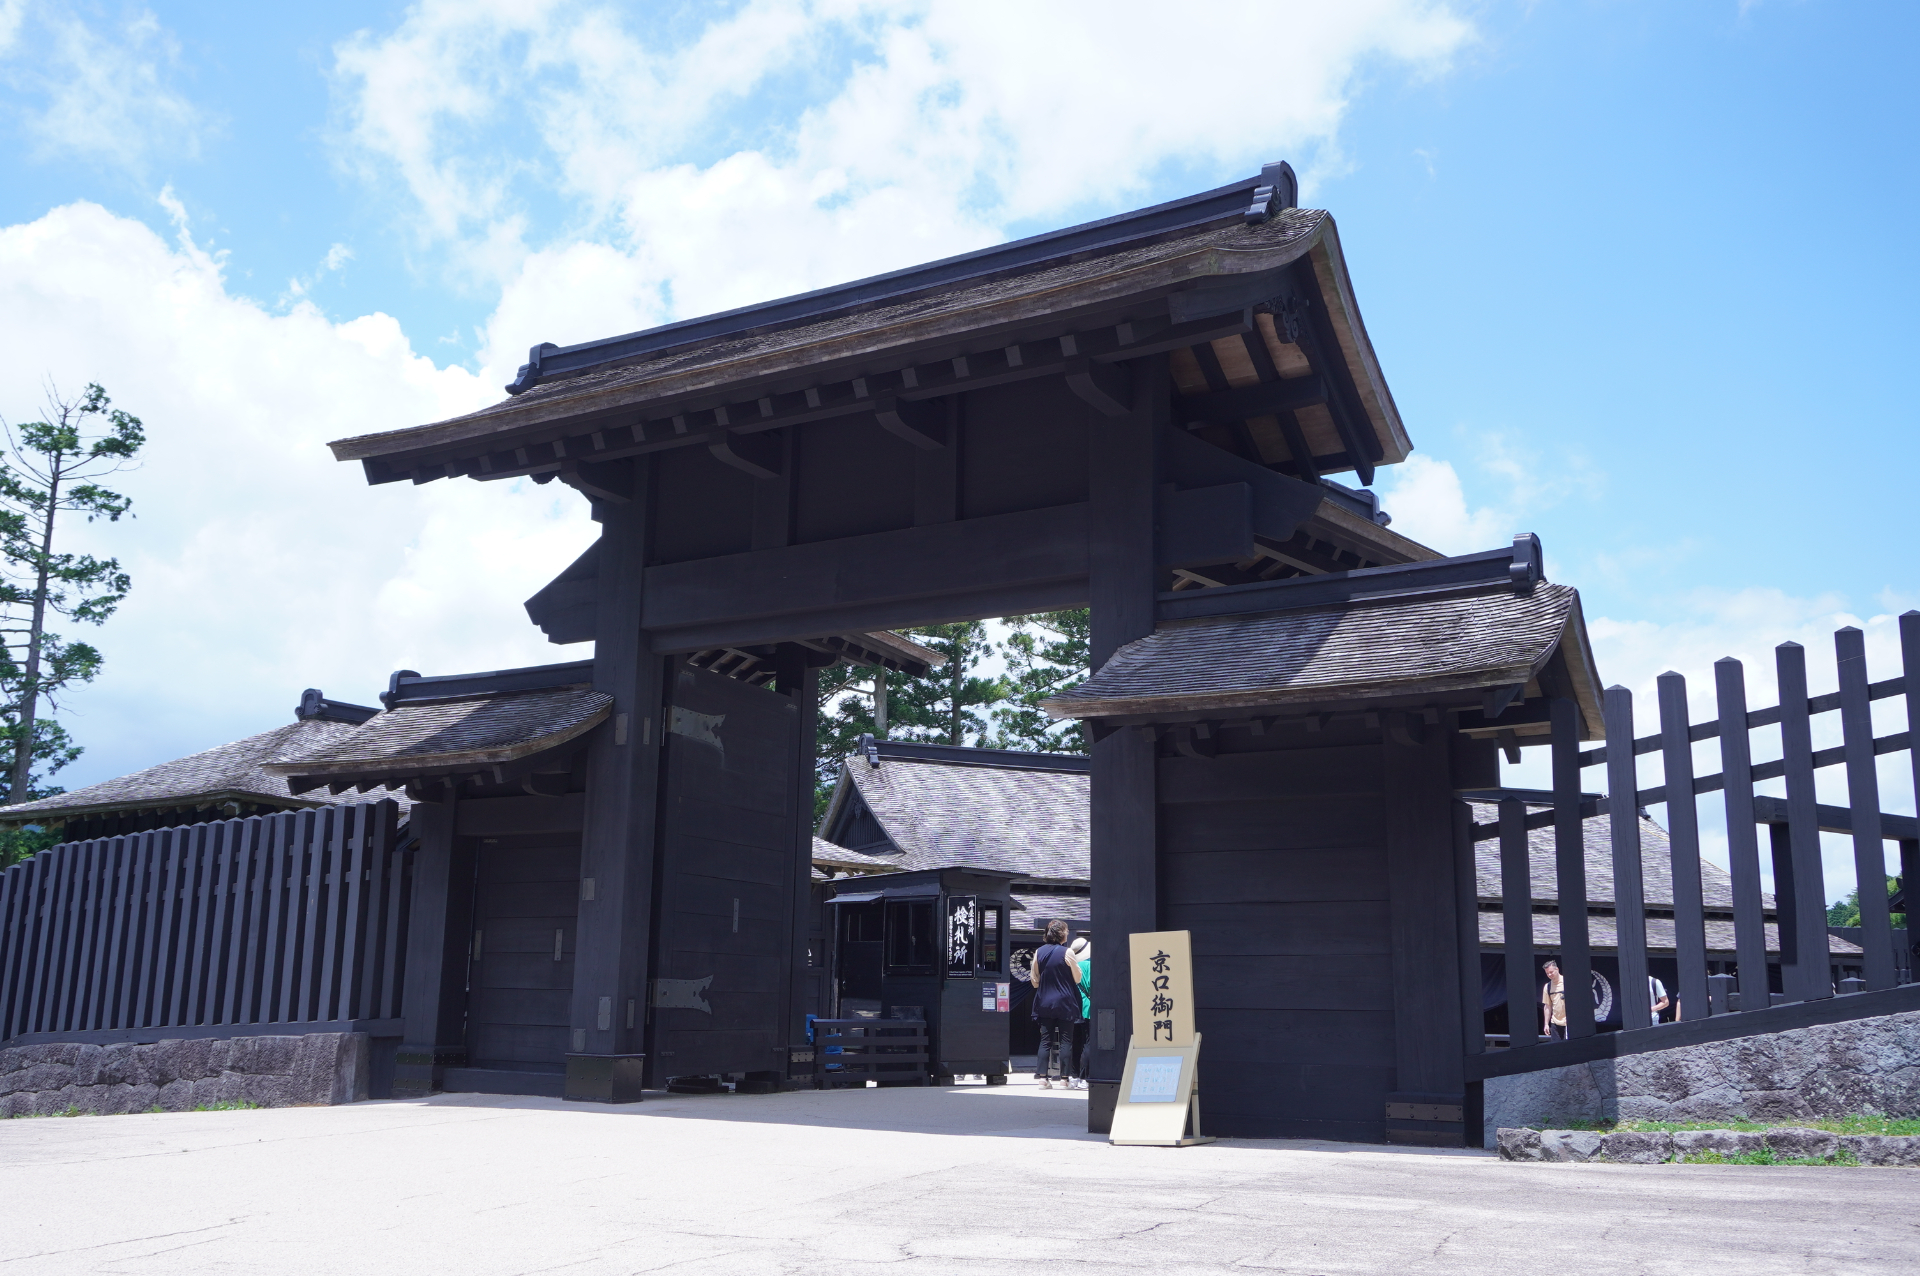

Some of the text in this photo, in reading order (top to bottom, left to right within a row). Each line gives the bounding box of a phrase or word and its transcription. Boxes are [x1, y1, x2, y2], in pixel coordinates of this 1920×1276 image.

[954, 906, 968, 965] 検札所
[1149, 950, 1173, 1042] 京口御門
